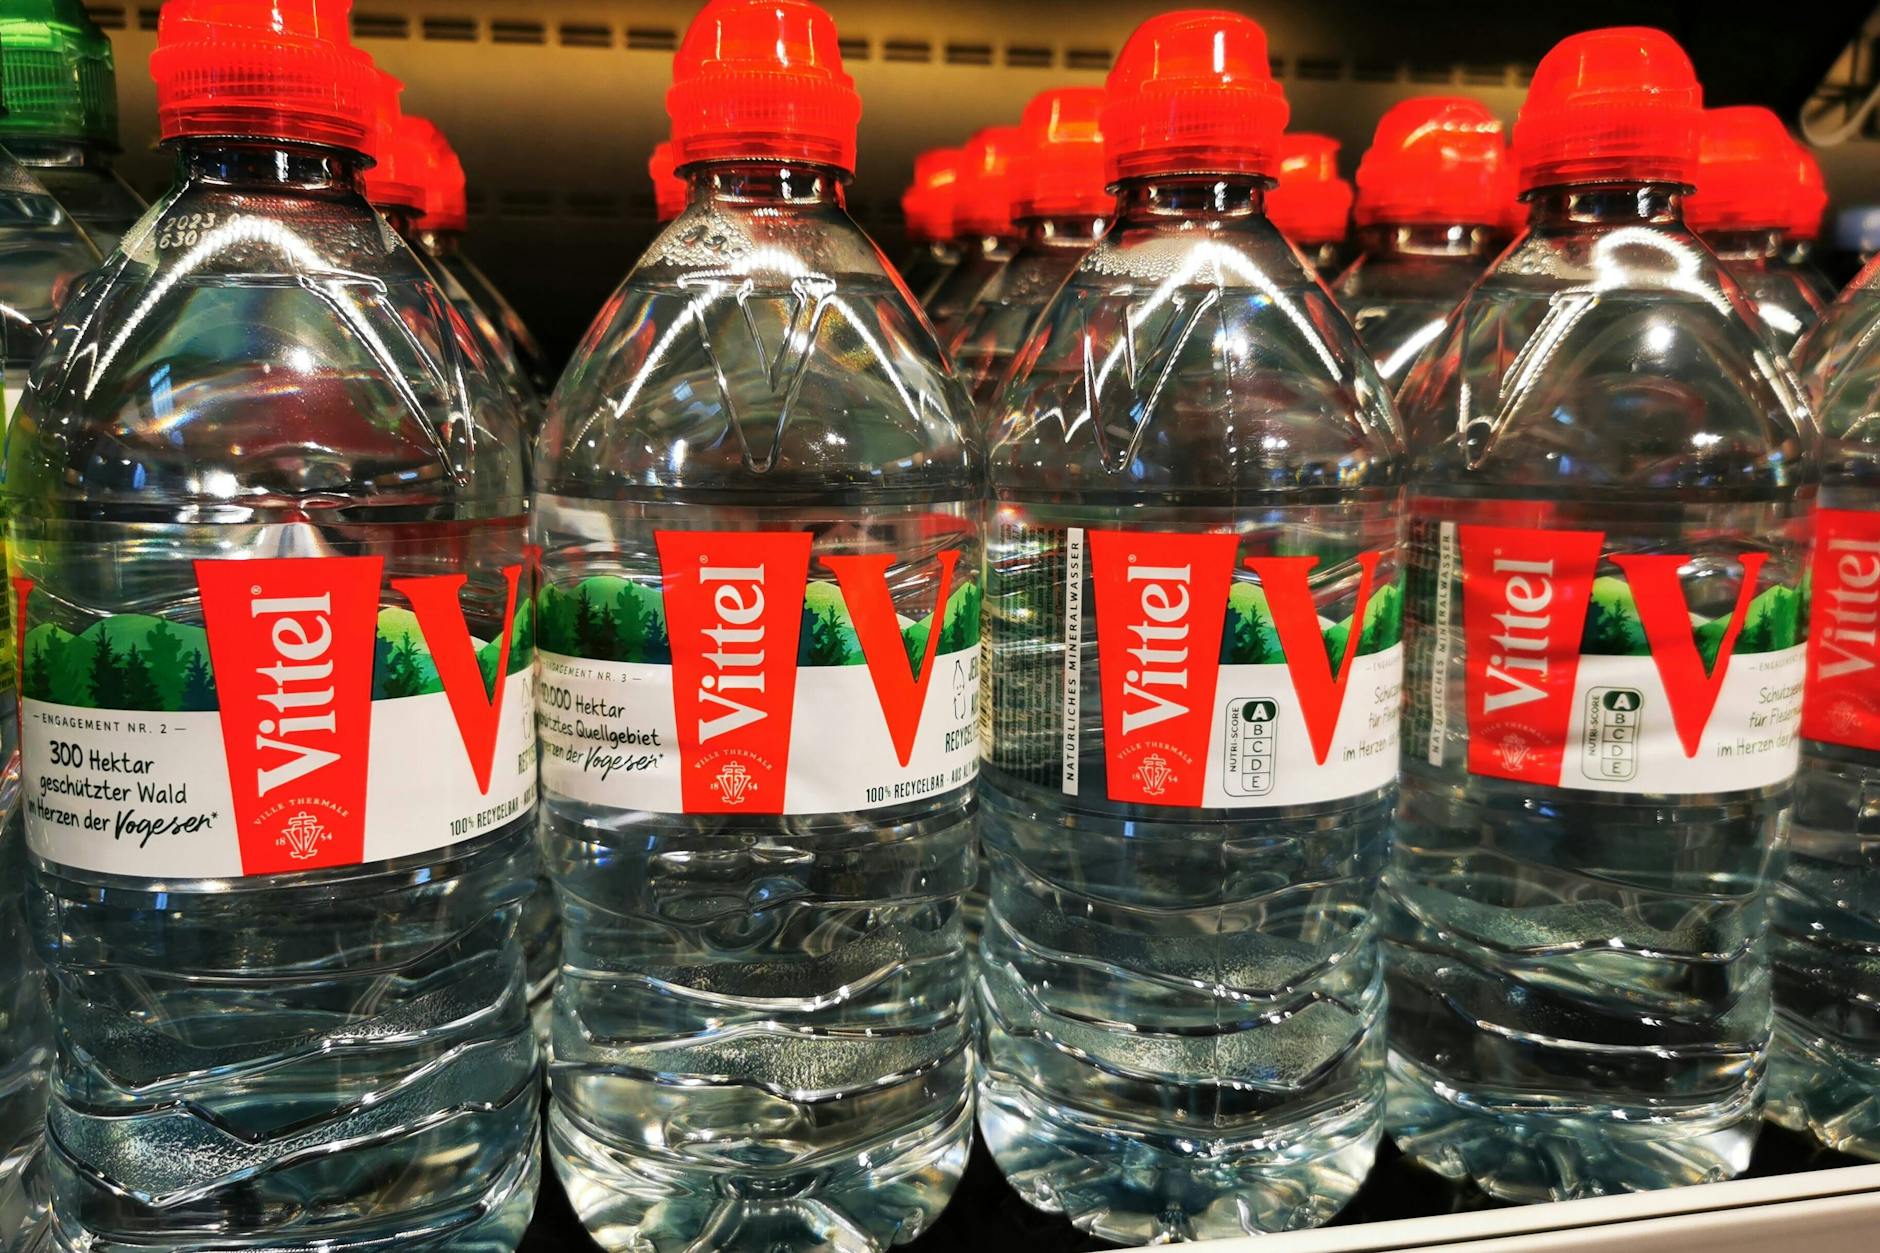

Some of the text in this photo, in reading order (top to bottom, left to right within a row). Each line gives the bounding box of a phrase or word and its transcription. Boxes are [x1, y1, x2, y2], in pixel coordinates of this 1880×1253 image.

[163, 212, 216, 232] 2023
[1438, 535, 1450, 652] MINERALWASSER
[1817, 539, 1880, 682] Vittel
[1484, 559, 1553, 715] Vittel
[699, 563, 768, 745] Vittel
[1122, 563, 1191, 736] Vittel
[1066, 542, 1080, 781] NATÜRLICHES MINERALWASSER
[597, 672, 615, 682] NR.
[621, 674, 627, 682] 3
[251, 590, 341, 797] Vittel
[1613, 693, 1631, 710] A
[576, 695, 625, 718] Hektar
[1251, 703, 1269, 720] A
[42, 713, 167, 734] ENGAGEMENT NR. 2
[1589, 695, 1600, 756] NUTRI-SCORE
[1615, 713, 1625, 724] B
[1749, 712, 1767, 728] für
[576, 719, 661, 749] Quellgebiet
[1229, 707, 1239, 772] NUTRI-SCORE
[1253, 724, 1263, 736] B
[1612, 728, 1624, 740] C
[49, 740, 155, 774] 300 Hektar
[566, 745, 584, 763] der
[1252, 740, 1263, 753] C
[1343, 746, 1355, 761] im
[1612, 745, 1623, 756] D
[1717, 743, 1732, 757] im
[1737, 736, 1774, 756] Herzen
[723, 748, 773, 770] THERMALE
[1251, 758, 1262, 771] D
[1612, 762, 1621, 774] E
[40, 774, 187, 804] geschützter Wald
[866, 786, 891, 803] 100%
[894, 773, 944, 799] RECYCELBAR
[1252, 775, 1260, 788] E
[37, 796, 80, 828] Herzen
[83, 809, 111, 832] der
[254, 797, 350, 825] VILLE THERMALE
[449, 813, 474, 837] 100%
[477, 797, 519, 829] RECYCELBAR
